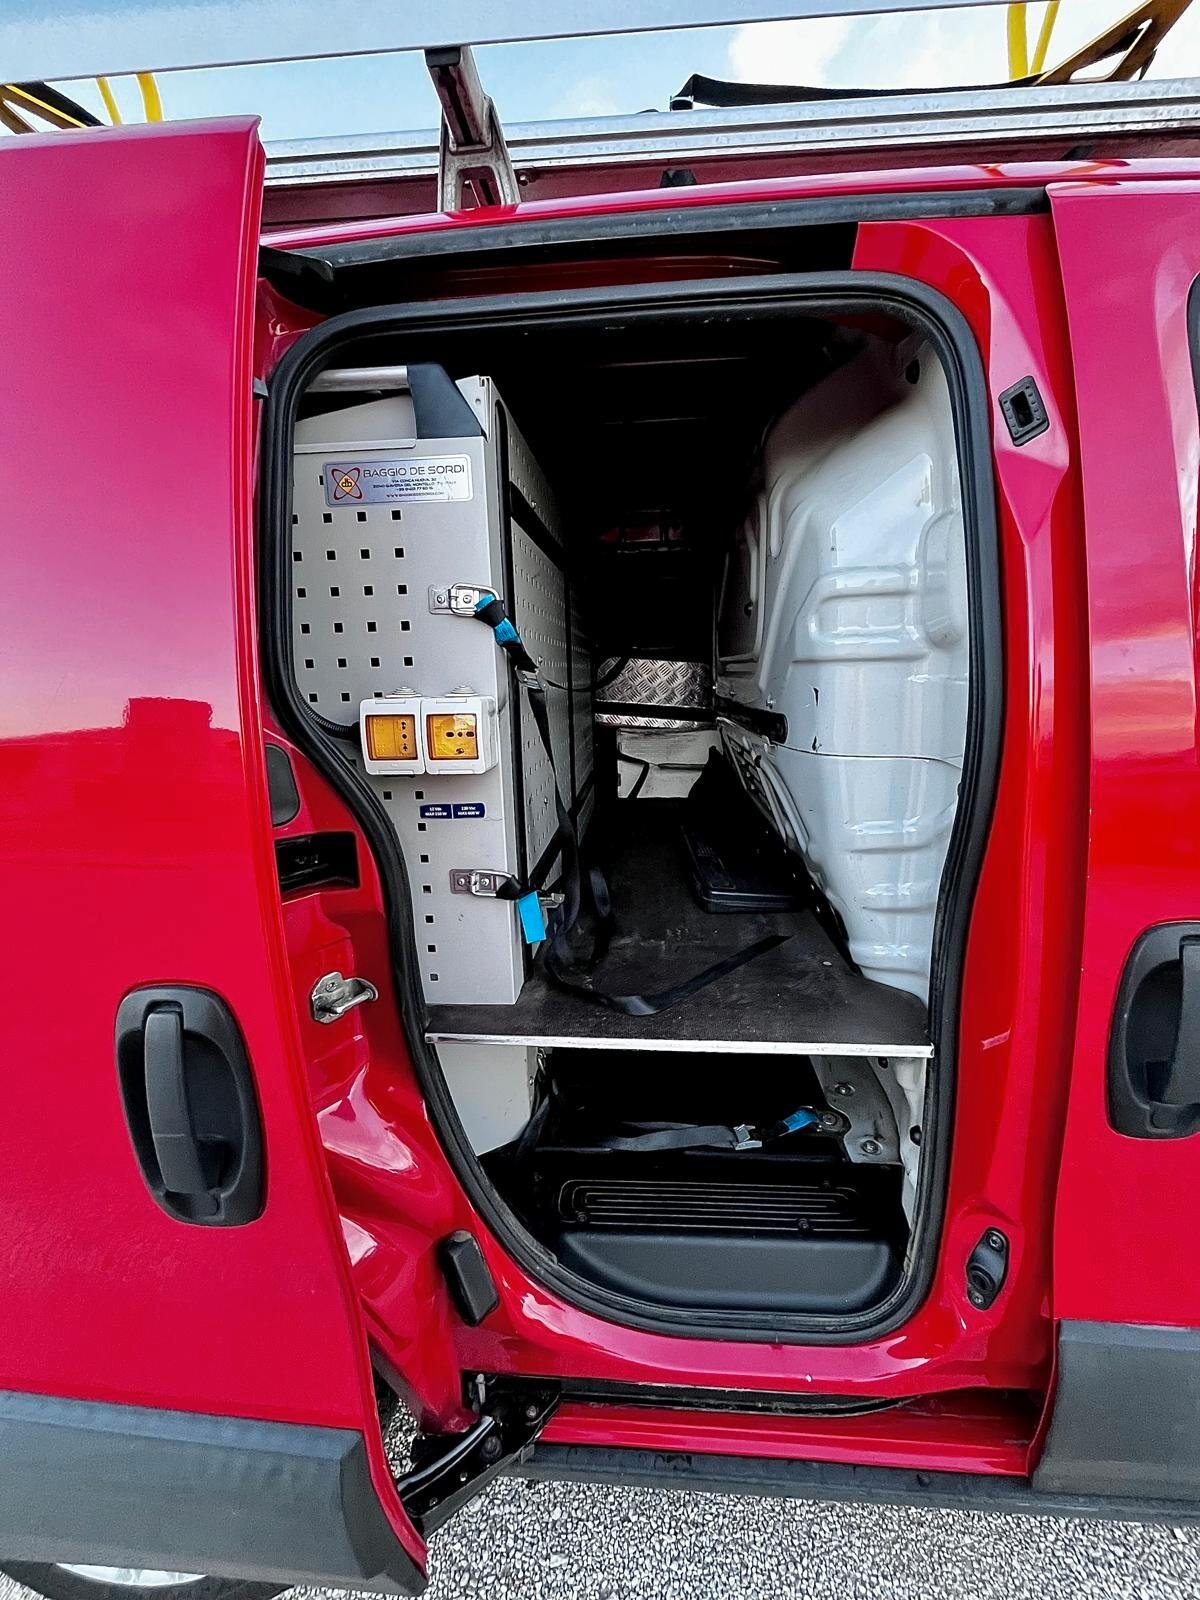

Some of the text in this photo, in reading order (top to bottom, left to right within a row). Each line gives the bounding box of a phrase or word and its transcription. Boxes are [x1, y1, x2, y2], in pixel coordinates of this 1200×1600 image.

[363, 464, 464, 478] BAGGIO DE SORDI
